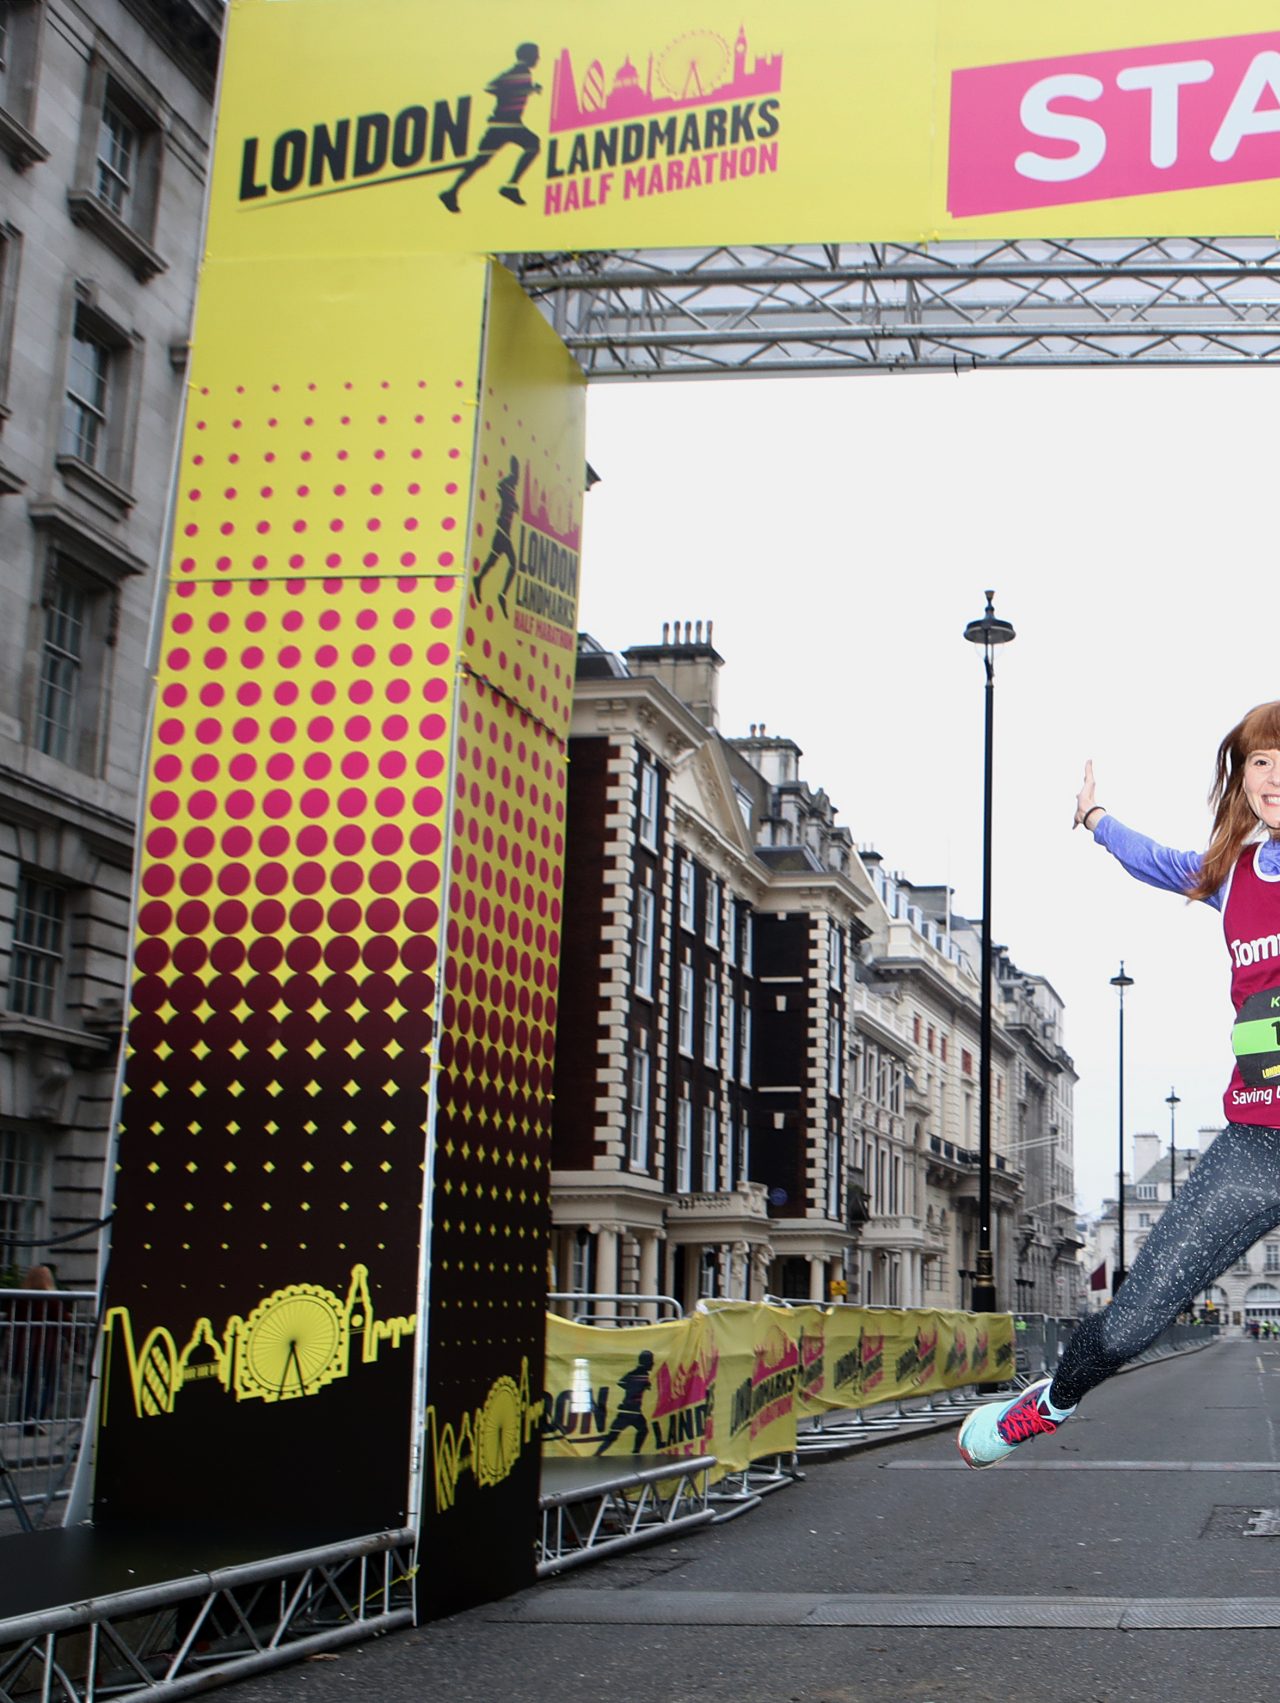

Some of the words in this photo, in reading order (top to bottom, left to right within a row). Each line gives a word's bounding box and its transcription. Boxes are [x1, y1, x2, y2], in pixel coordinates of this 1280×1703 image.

[239, 95, 472, 202] LONDON
[546, 98, 782, 179] LANDMARKS
[543, 173, 612, 216] HALF
[622, 142, 781, 200] MARATHON
[518, 523, 579, 599] LONDON
[1232, 1086, 1272, 1105] Saving
